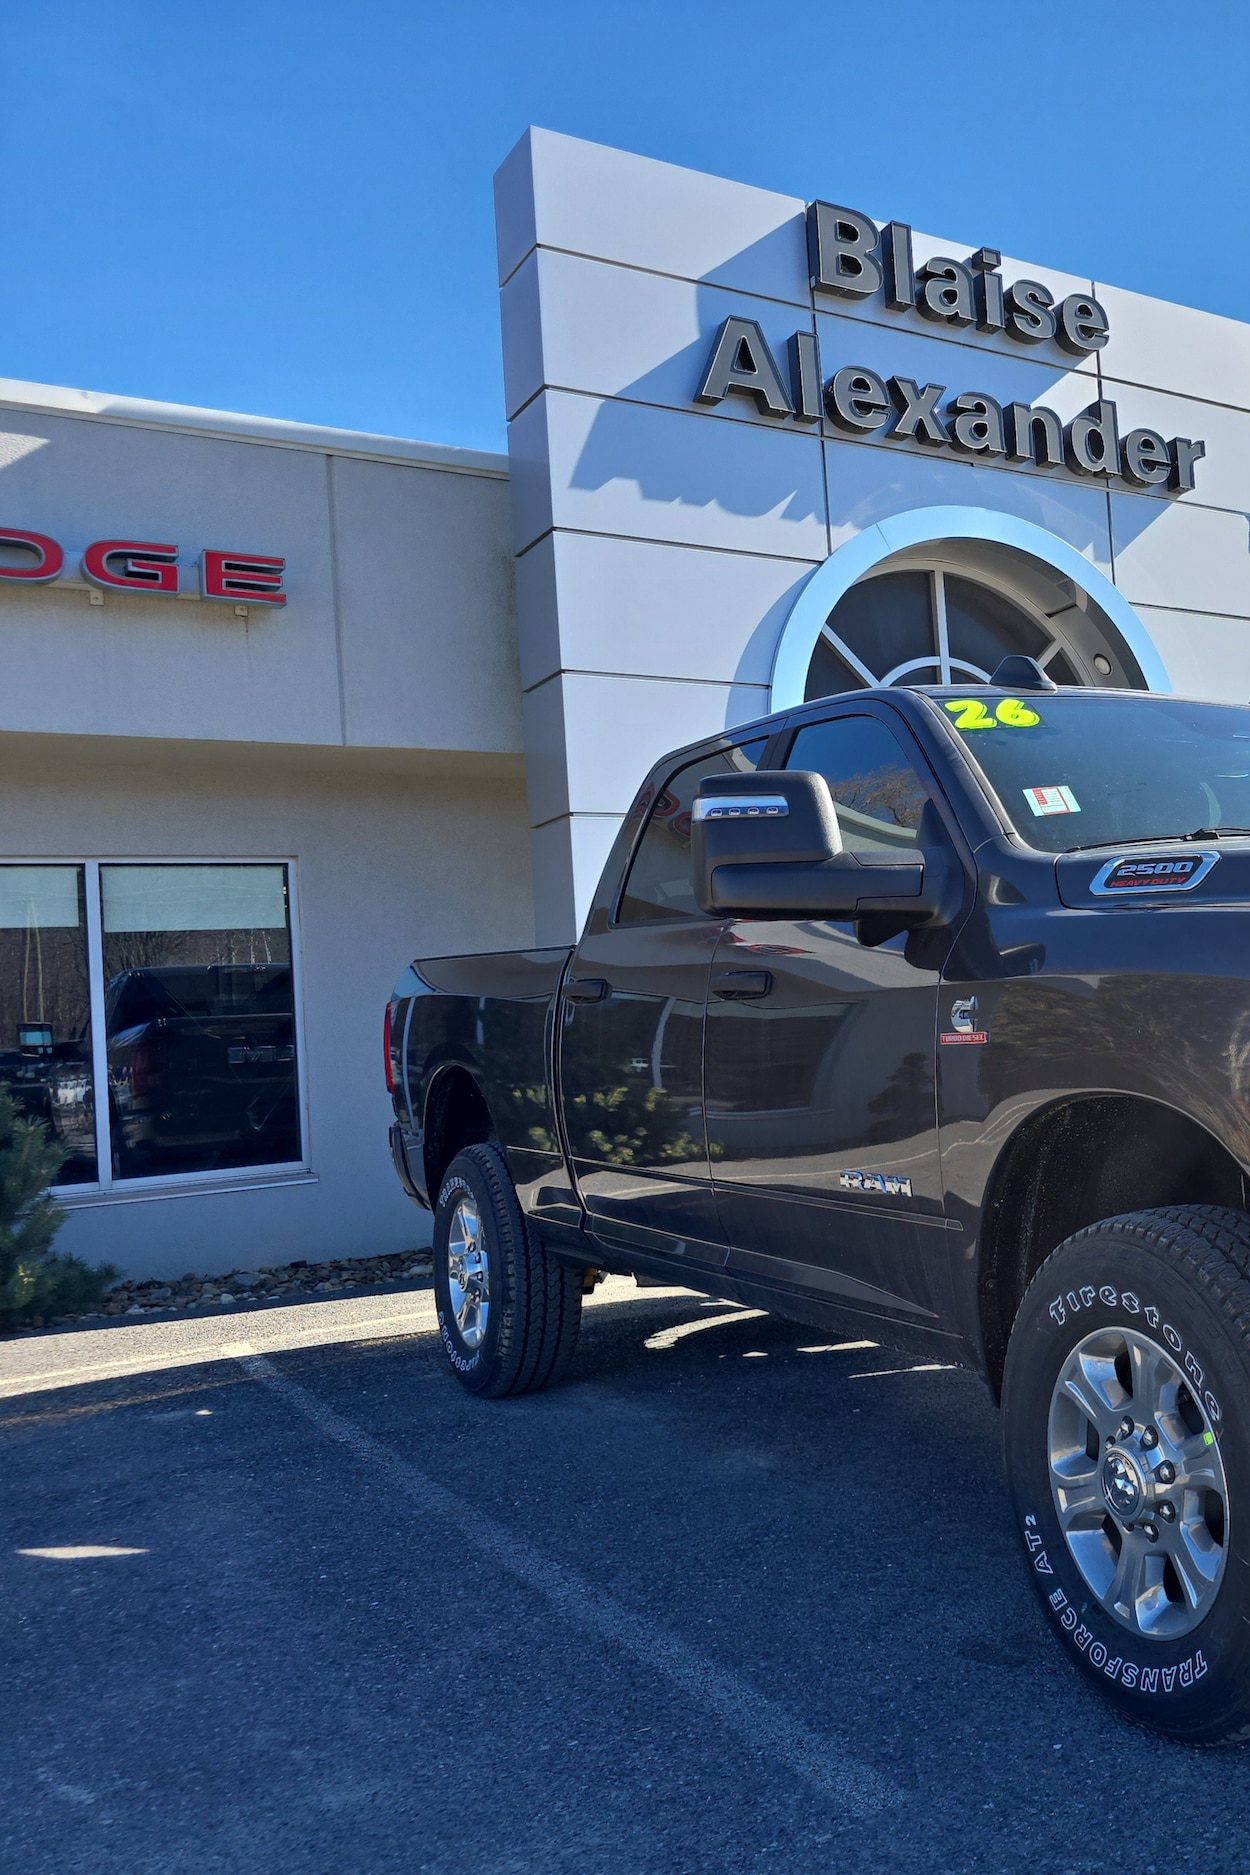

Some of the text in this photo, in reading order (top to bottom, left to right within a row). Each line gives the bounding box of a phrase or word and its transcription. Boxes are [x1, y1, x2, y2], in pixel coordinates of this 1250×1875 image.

[807, 199, 1110, 357] Blaise
[694, 315, 1206, 494] Alexander
[944, 698, 1041, 731] 26
[1110, 876, 1187, 888] HEAVY DUTY
[1116, 861, 1194, 877] 2500
[839, 1169, 914, 1198] RAM
[1048, 1586, 1209, 1694] TRANSFORCE
